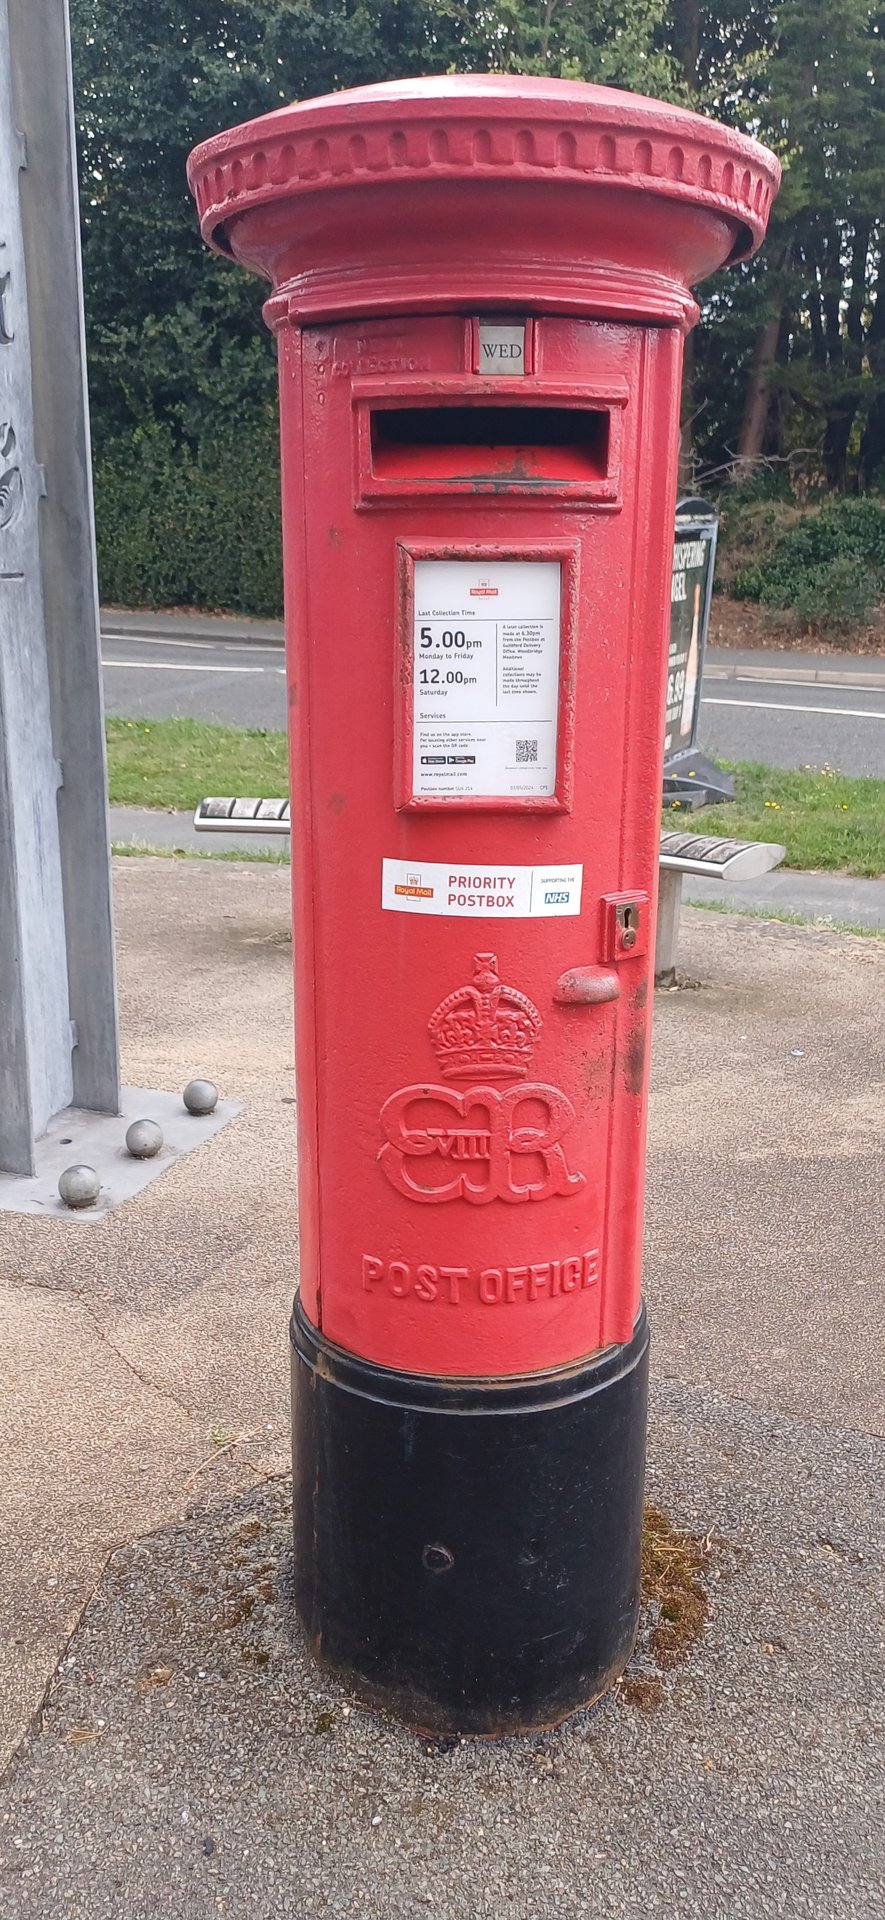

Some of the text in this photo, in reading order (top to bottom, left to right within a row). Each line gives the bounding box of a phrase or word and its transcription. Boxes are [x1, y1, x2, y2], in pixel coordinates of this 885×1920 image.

[482, 344, 522, 358] WED
[420, 627, 482, 650] 5.00pm
[419, 669, 477, 685] 12.00pm
[449, 875, 516, 889] PRIORITY
[396, 886, 432, 897] Royal Mail
[546, 892, 570, 904] NHS
[448, 894, 515, 908] POSTBOX
[362, 1248, 600, 1305] POST OFFICE
